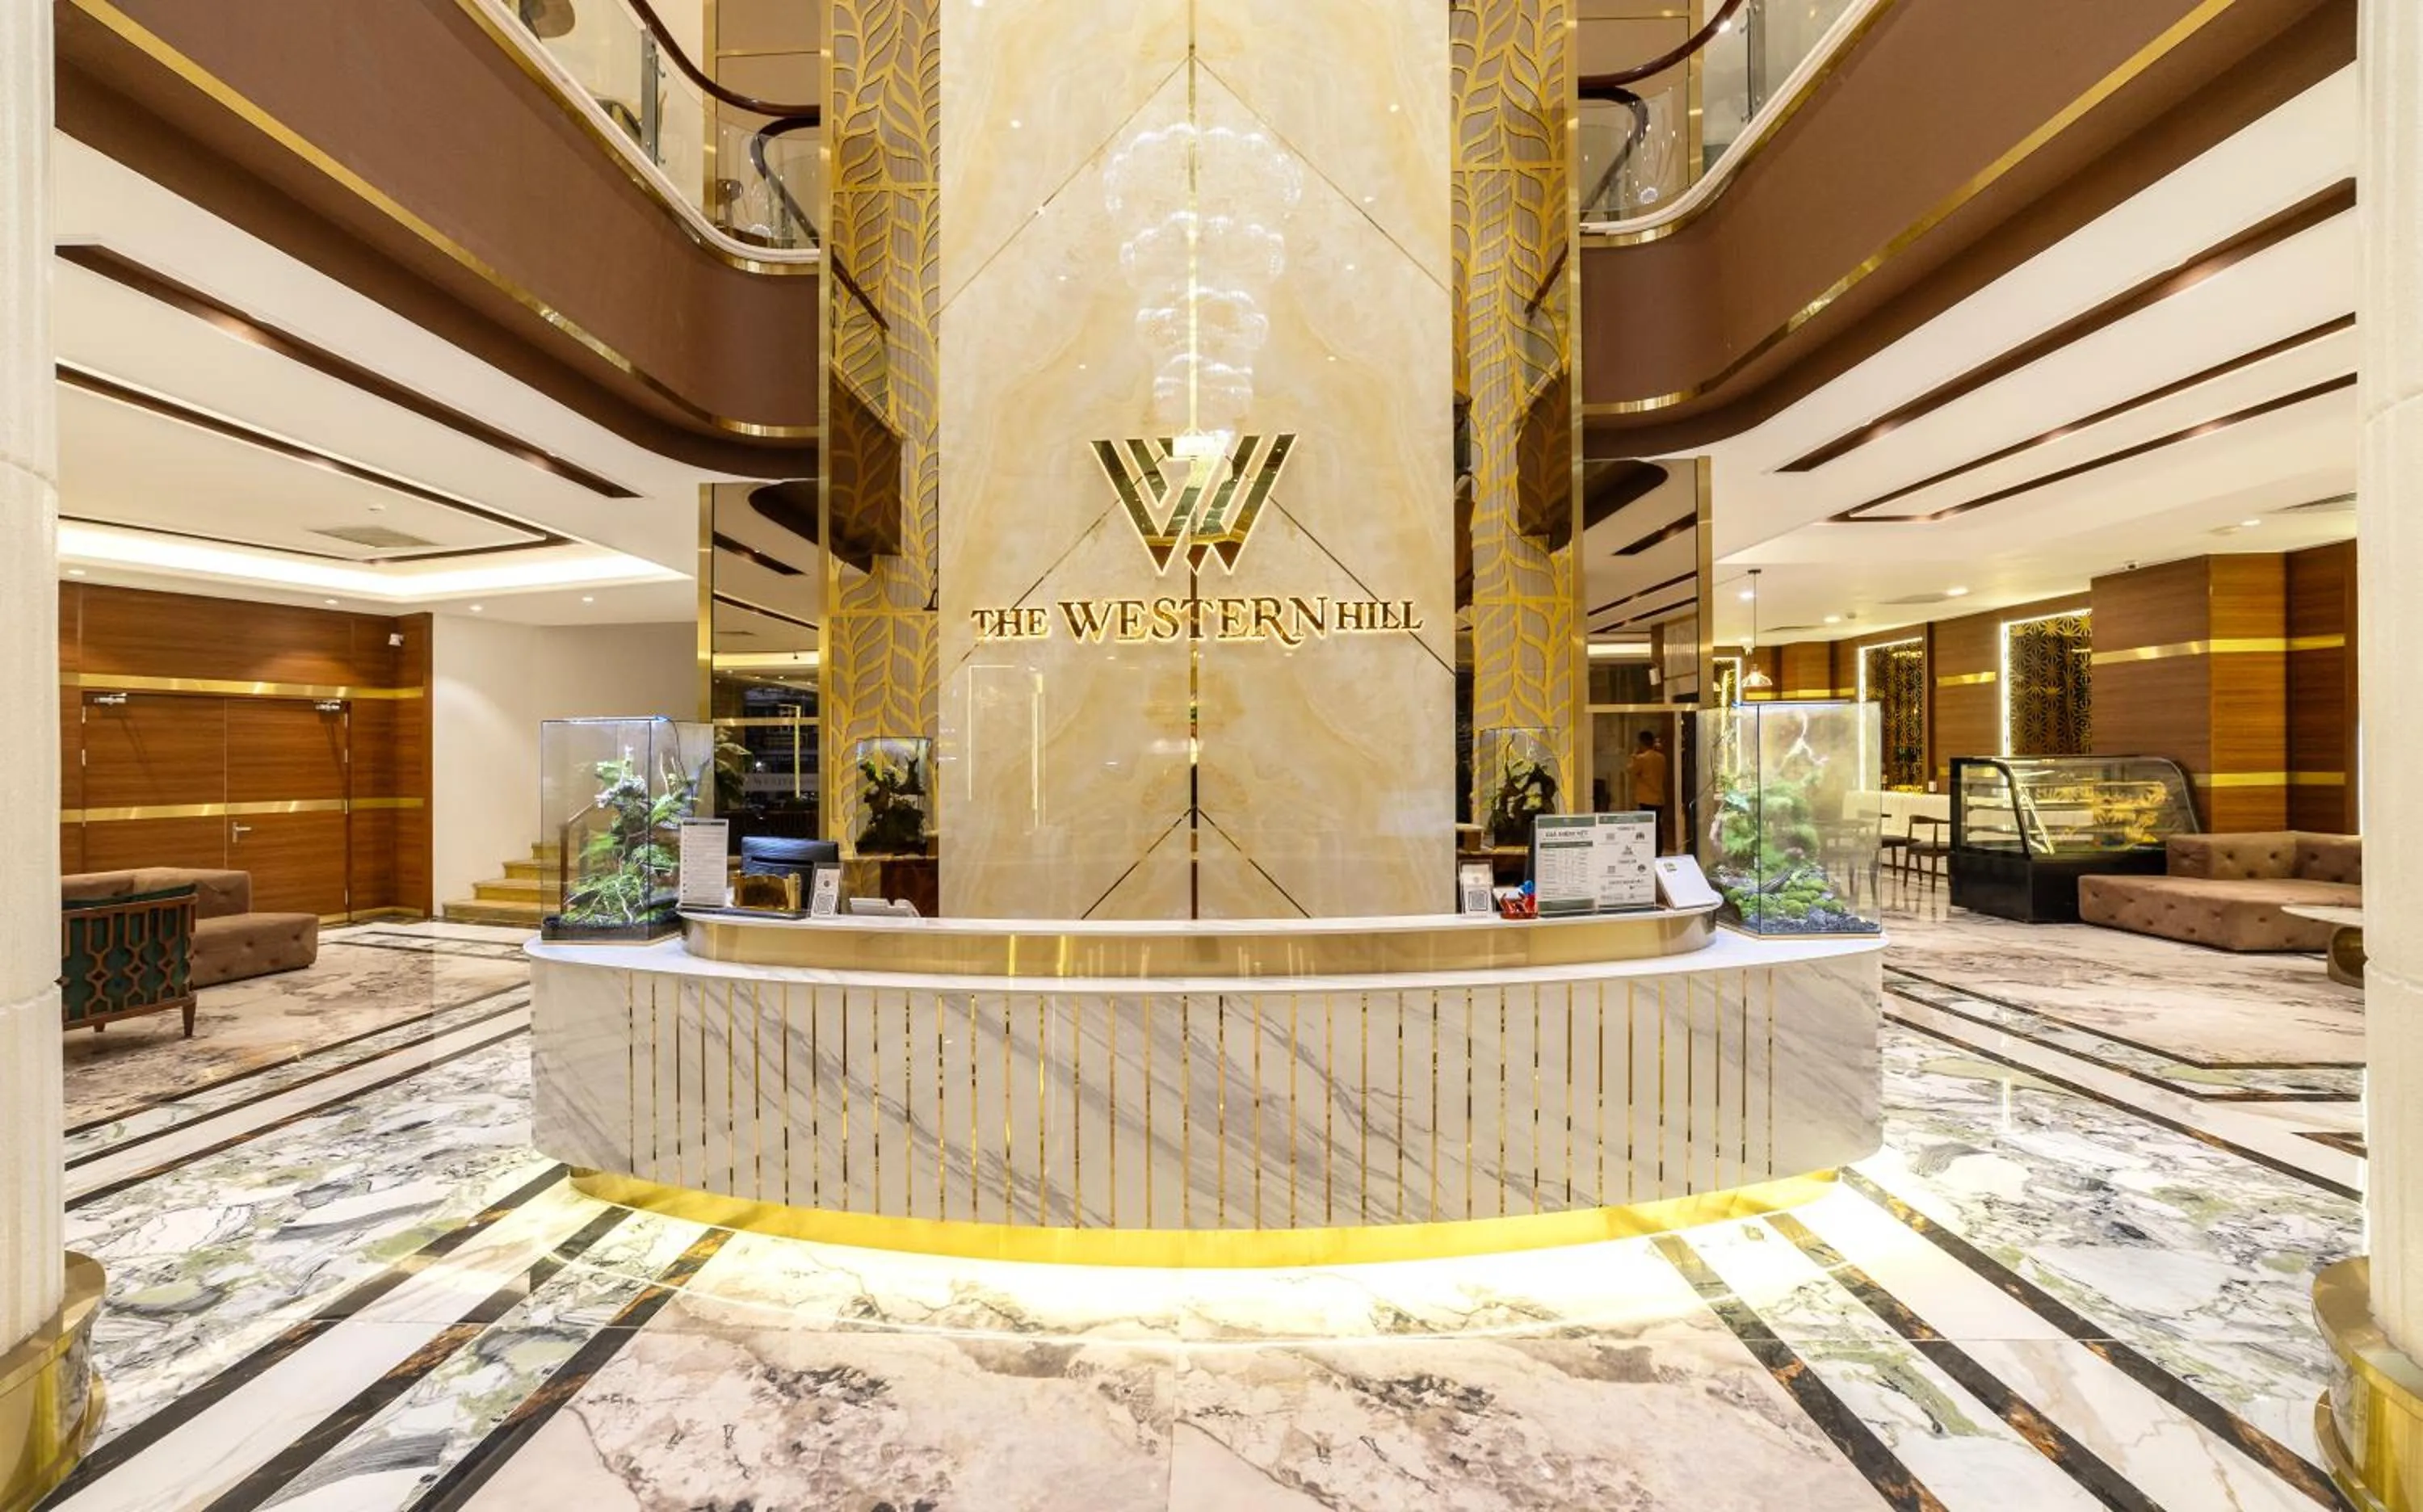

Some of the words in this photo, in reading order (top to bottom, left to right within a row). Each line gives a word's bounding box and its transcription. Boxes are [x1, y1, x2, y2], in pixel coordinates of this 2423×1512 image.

[971, 607, 1048, 638] THE
[1057, 596, 1329, 645] WESTERN
[1335, 601, 1424, 631] HILL
